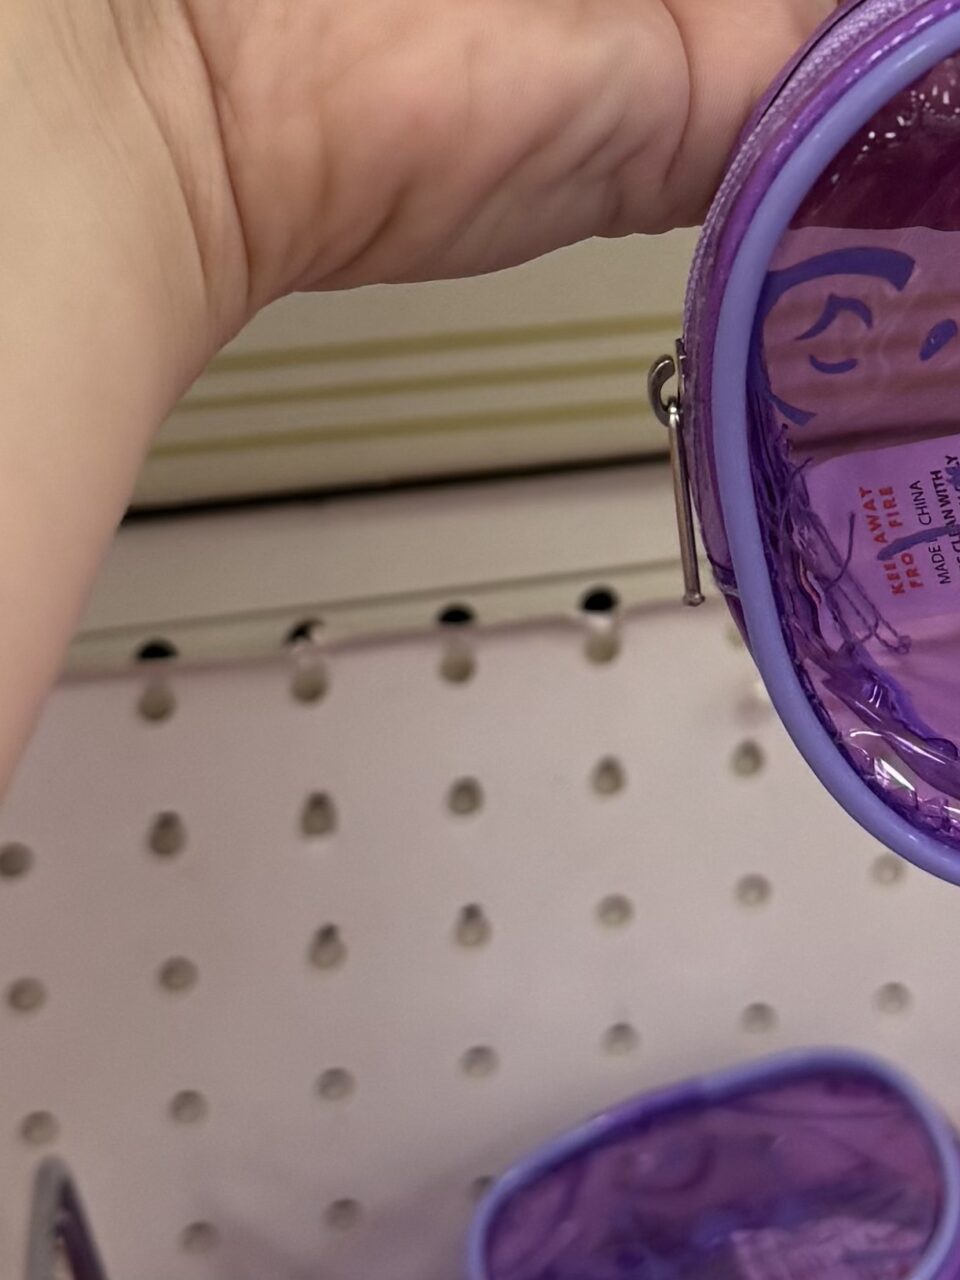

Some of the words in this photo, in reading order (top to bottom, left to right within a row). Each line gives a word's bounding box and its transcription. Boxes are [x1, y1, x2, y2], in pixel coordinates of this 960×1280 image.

[878, 486, 903, 528] FIRE
[909, 480, 932, 526] CHINA
[930, 470, 951, 508] WITH
[859, 486, 888, 544] AWAY
[881, 556, 905, 595] KEE
[900, 549, 924, 589] FRO
[928, 544, 952, 585] MADE
